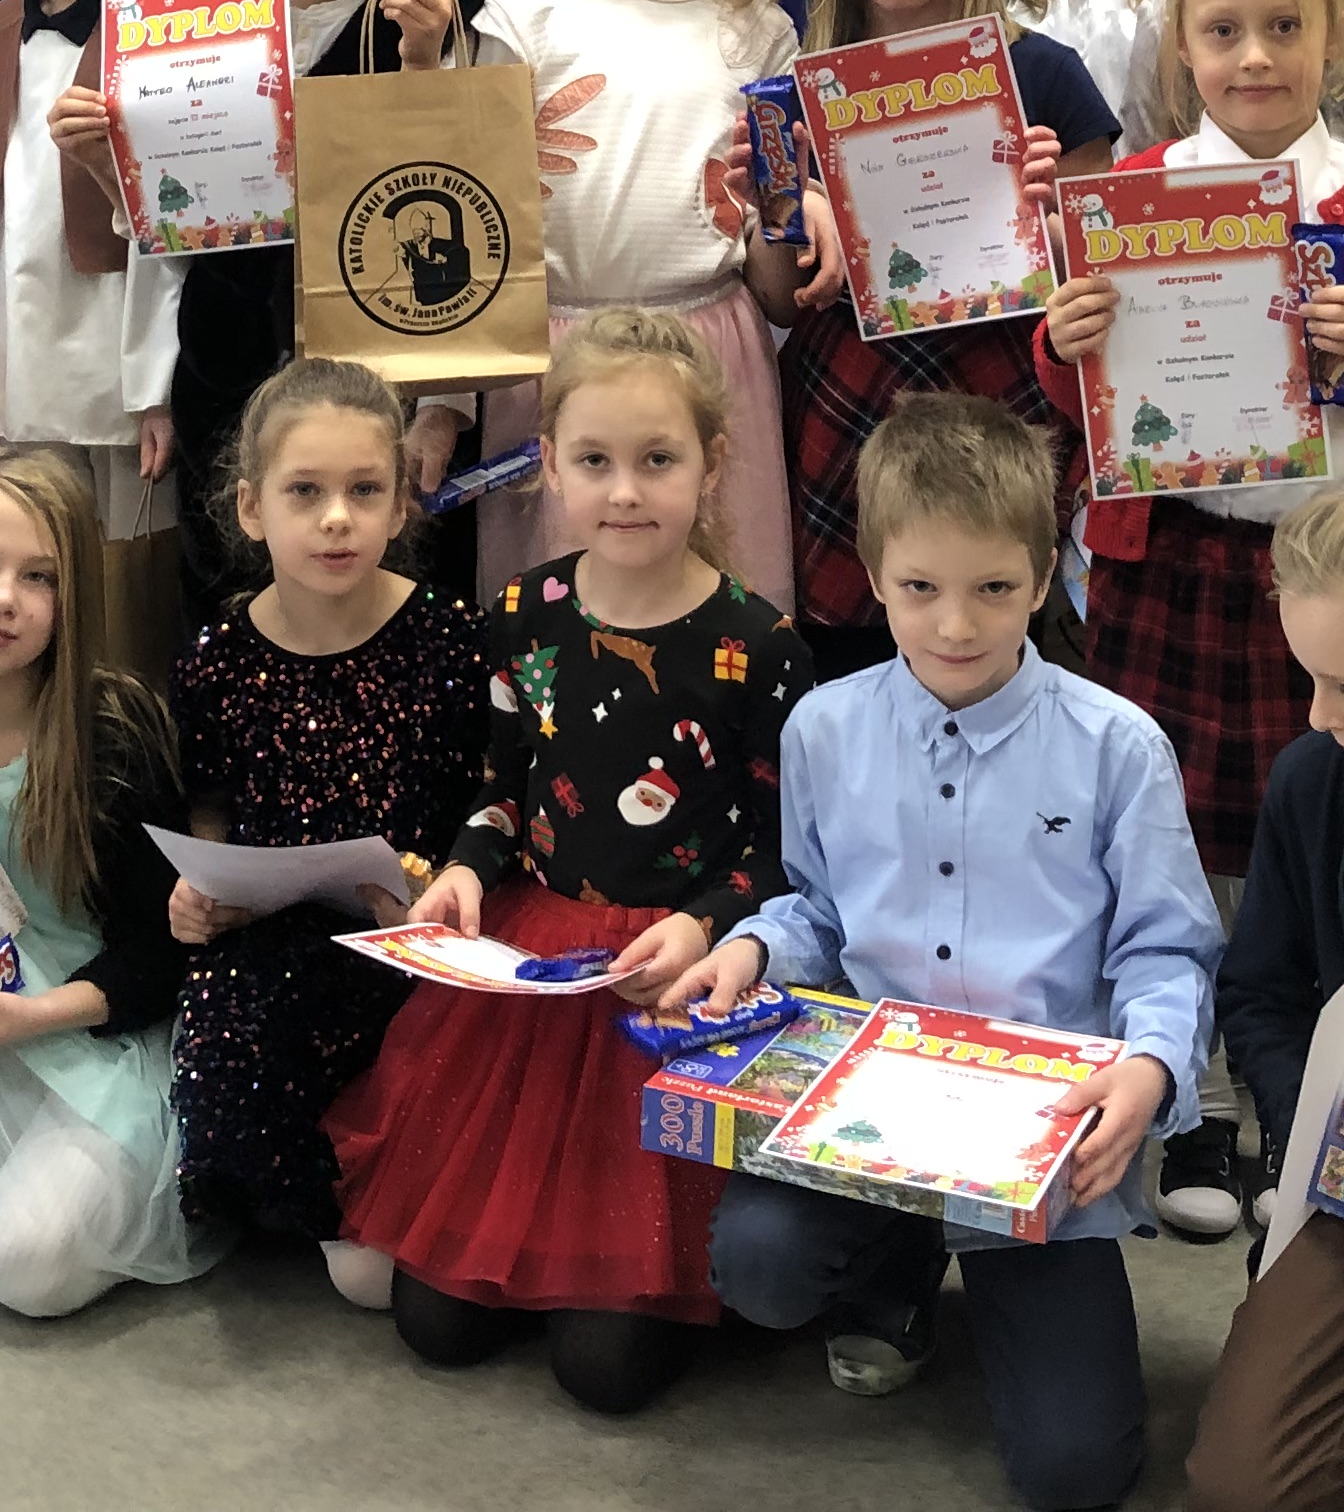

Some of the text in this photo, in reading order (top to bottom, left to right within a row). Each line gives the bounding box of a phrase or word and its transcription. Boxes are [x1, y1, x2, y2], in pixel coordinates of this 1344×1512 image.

[170, 54, 221, 68] otrzymuje
[825, 63, 1001, 130] DYPLOM
[892, 126, 948, 144] otrzymuje
[922, 170, 935, 178] za
[349, 172, 501, 275] KATOLICKIE SZKOŁY NIEPUBLICZNE
[1085, 212, 1289, 263] DYPLOM
[1158, 272, 1222, 286] otrzymuje
[1184, 320, 1200, 328] za
[874, 1029, 1096, 1083] DYPLOM
[660, 1094, 684, 1152] 300
